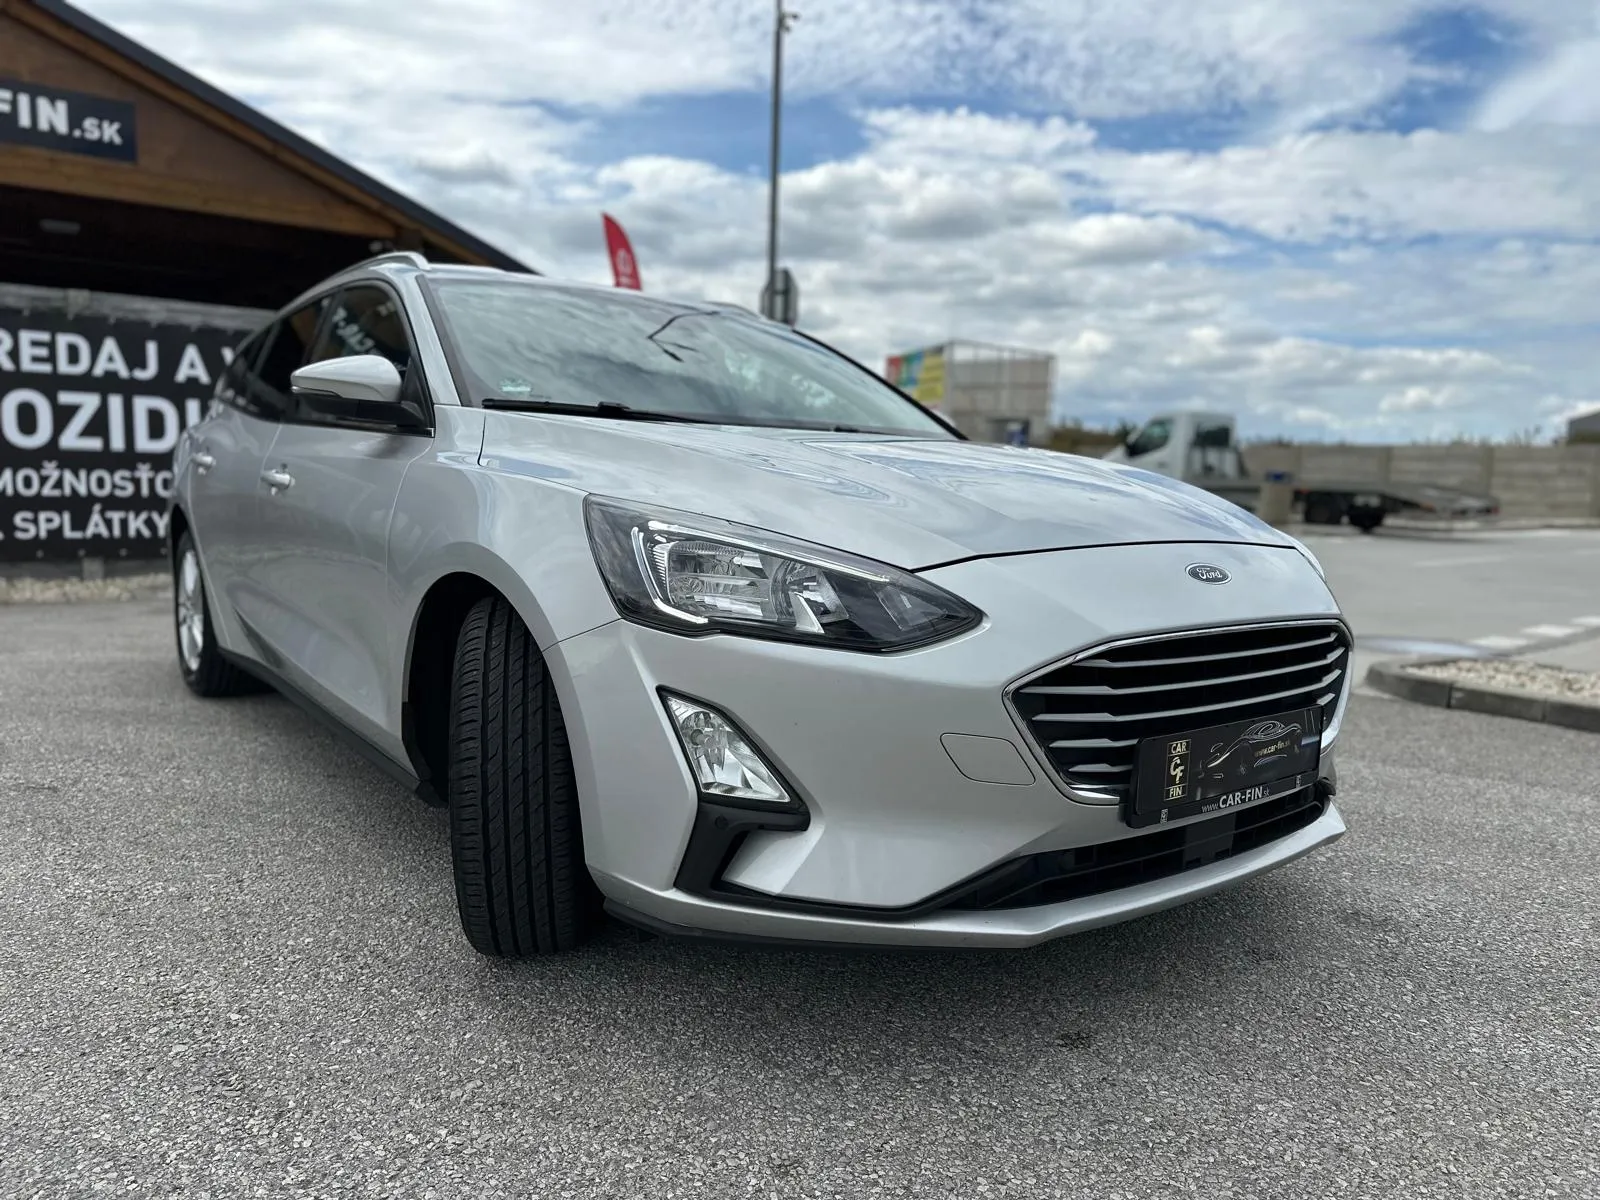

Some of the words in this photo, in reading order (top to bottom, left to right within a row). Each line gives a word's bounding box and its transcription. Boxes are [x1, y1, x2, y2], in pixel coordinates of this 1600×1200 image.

[174, 344, 211, 385] A
[13, 503, 169, 541] SPLÁTKY
[1171, 741, 1187, 754] CAR
[1169, 786, 1183, 798] FIN
